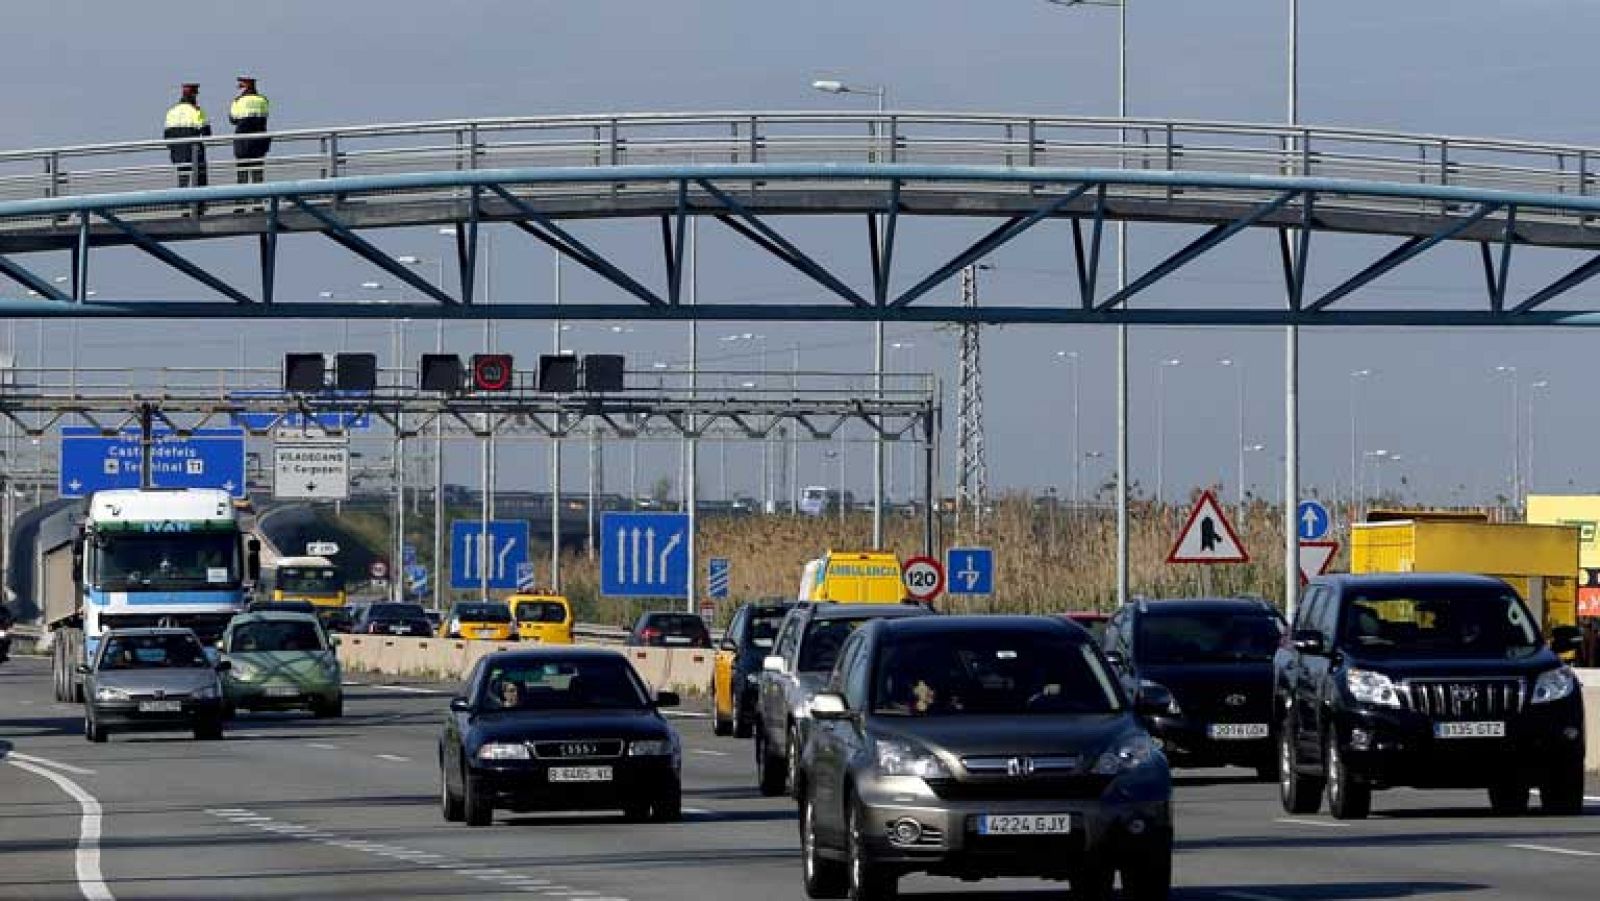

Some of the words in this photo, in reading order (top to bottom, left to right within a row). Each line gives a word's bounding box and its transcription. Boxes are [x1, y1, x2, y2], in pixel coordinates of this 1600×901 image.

[124, 460, 182, 472] Terinal
[143, 520, 191, 533] IVAN
[908, 571, 936, 587] 120
[991, 816, 1030, 832] 4224
[1034, 816, 1066, 831] GJY
